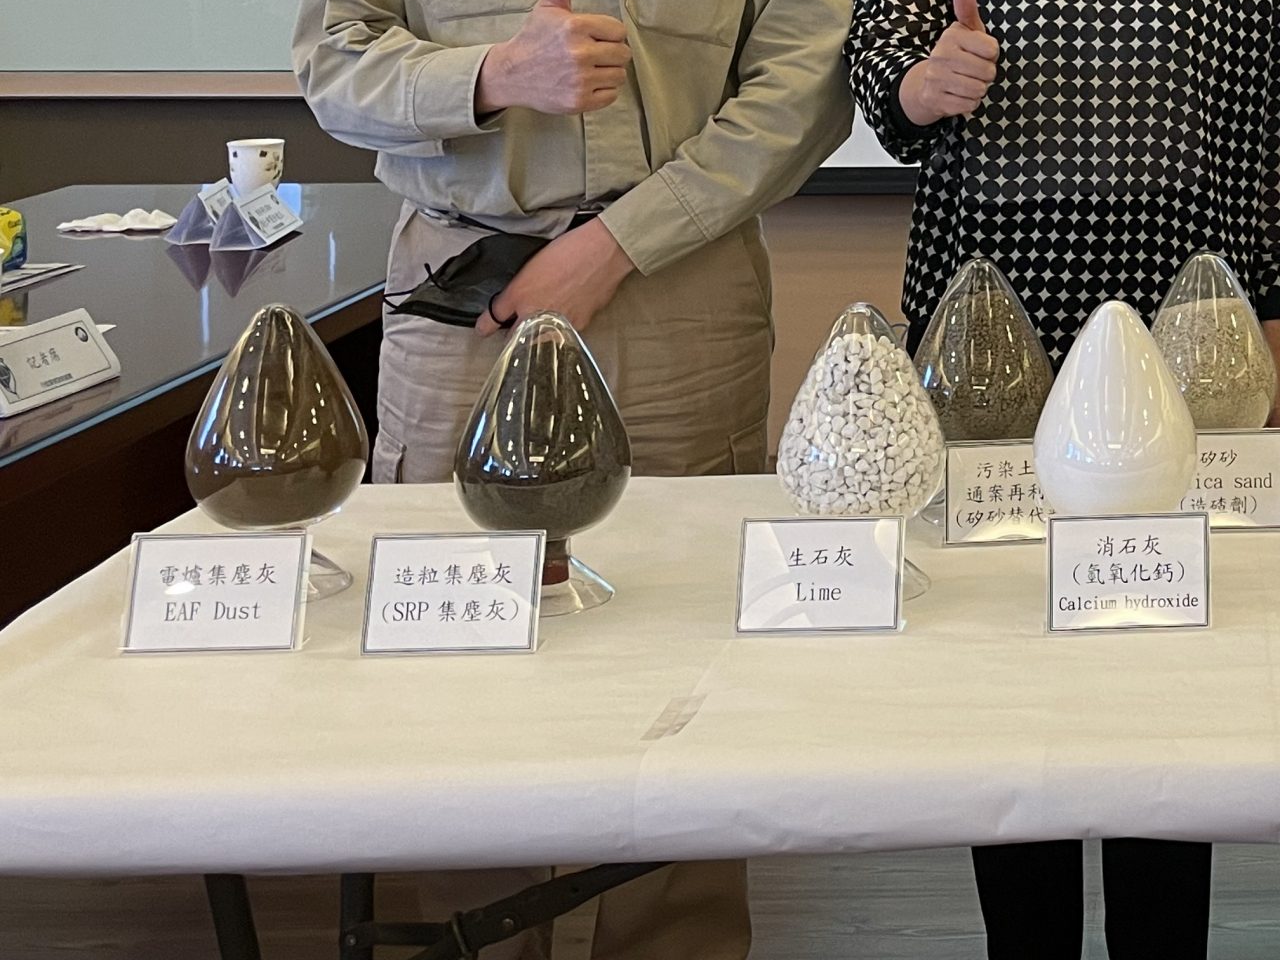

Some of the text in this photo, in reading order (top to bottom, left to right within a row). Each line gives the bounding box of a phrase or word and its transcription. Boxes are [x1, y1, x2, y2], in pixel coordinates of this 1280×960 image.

[977, 460, 1036, 479] 污染土
[1200, 449, 1239, 468] 矽砂
[1195, 472, 1273, 490] ica sand
[966, 483, 1045, 504] 通案再利
[956, 507, 1056, 529] (矽砂替代
[787, 545, 855, 568] 生石灰
[1096, 534, 1163, 557] 消石灰
[393, 562, 513, 586] 造粒集塵灰
[1072, 561, 1186, 586] (氫氧化鈣)
[795, 582, 842, 602] Lime
[1058, 593, 1199, 612] Calcium hydroxide
[164, 600, 262, 622] EAF Dust
[382, 598, 520, 624] (SRP 集塵灰)
